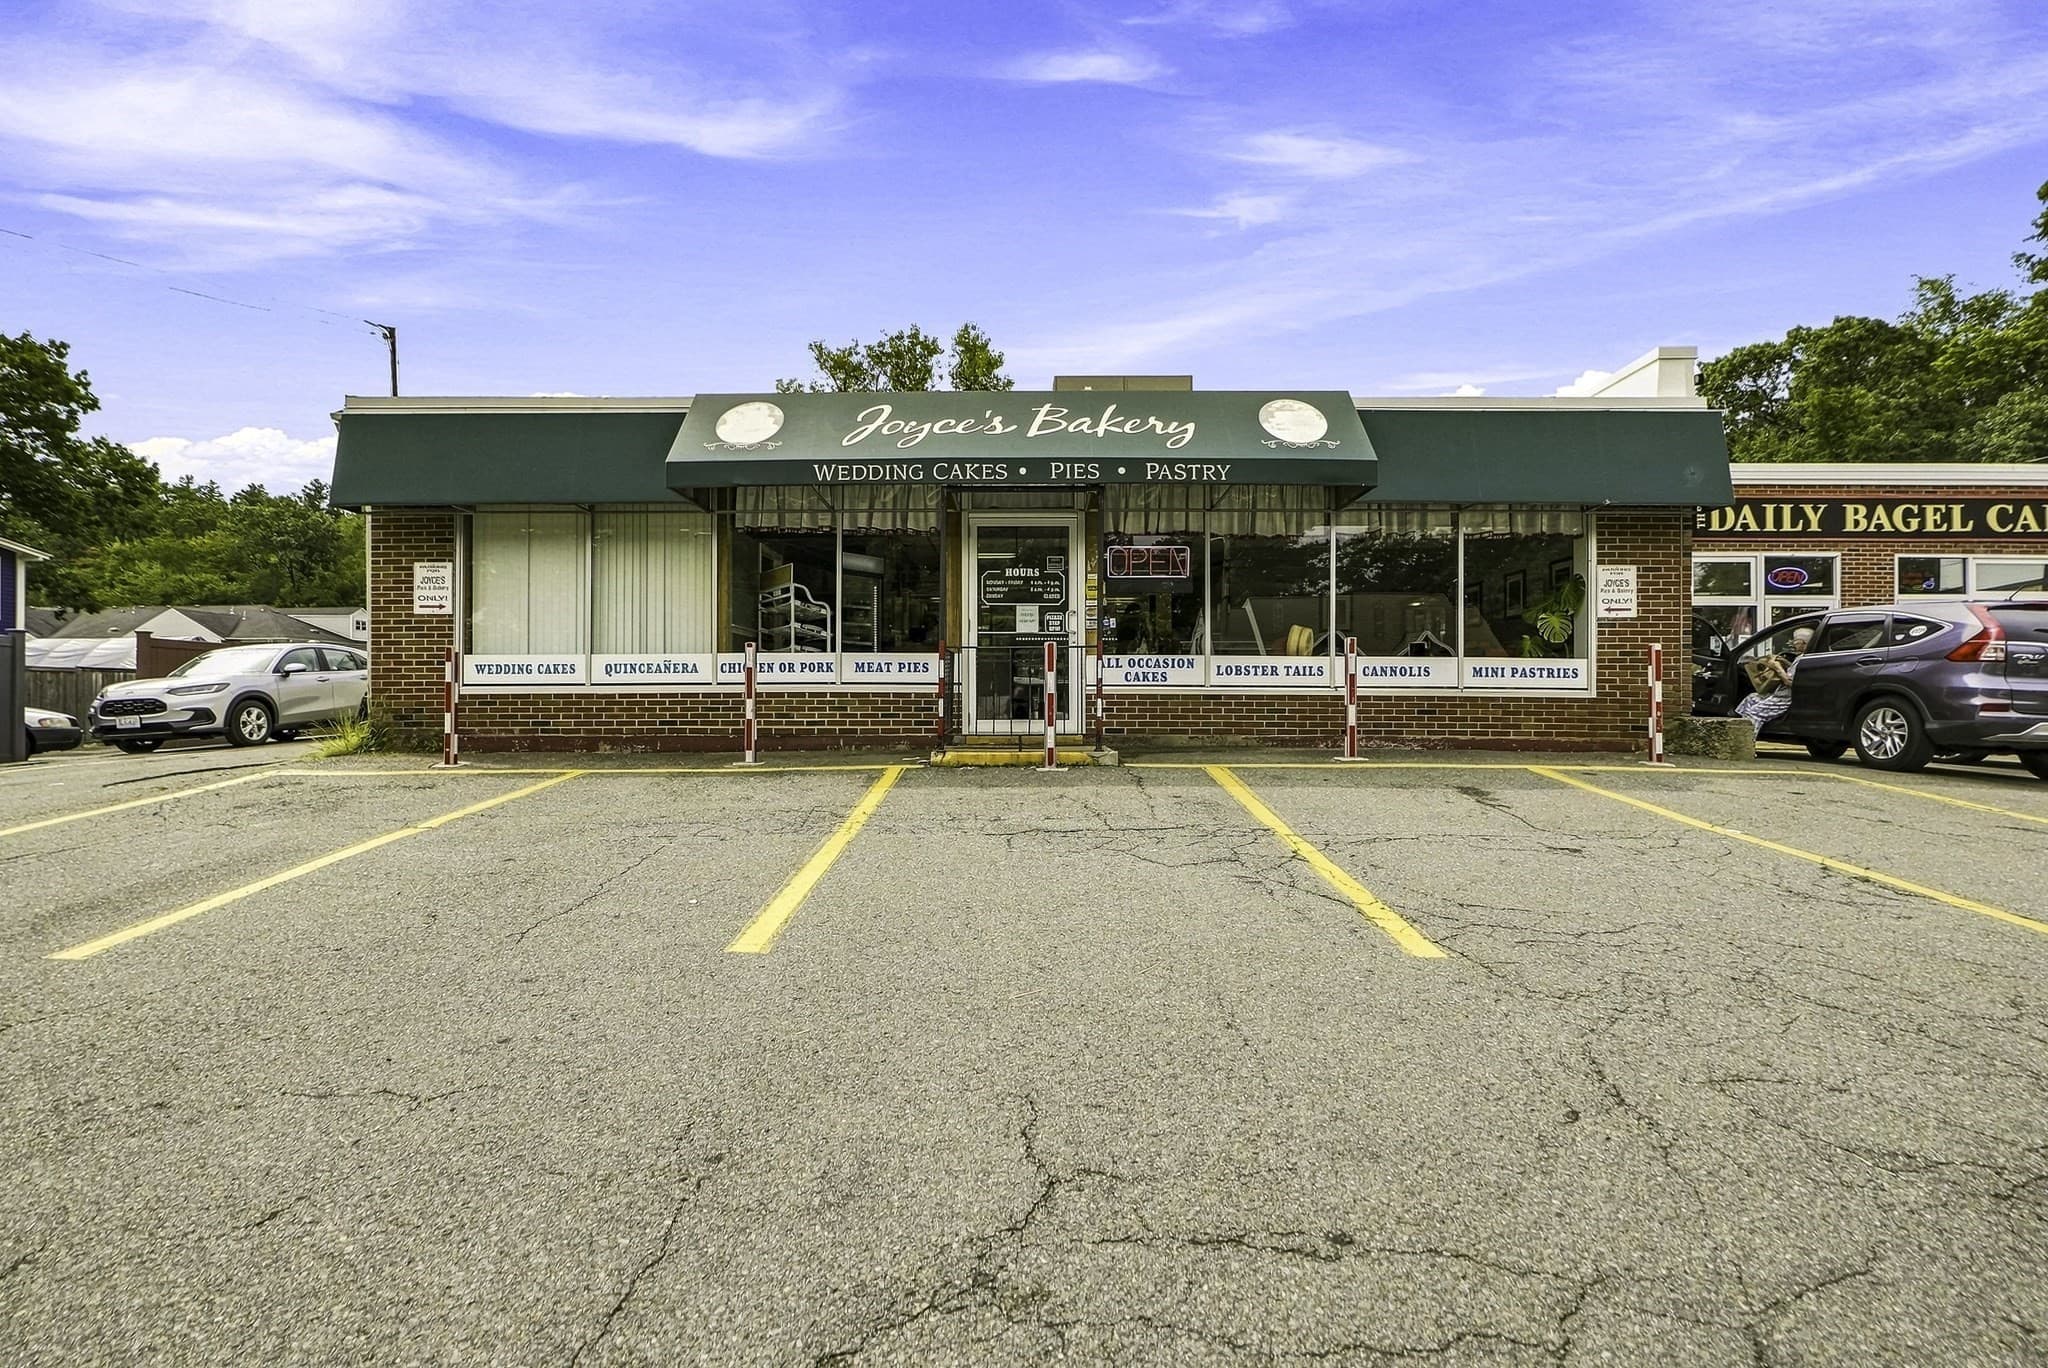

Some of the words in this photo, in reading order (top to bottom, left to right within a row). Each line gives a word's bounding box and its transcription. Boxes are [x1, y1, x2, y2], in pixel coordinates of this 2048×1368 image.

[841, 404, 1018, 449] Joyce's
[1026, 403, 1196, 449] Bakery
[812, 463, 924, 481] WEDDING
[933, 463, 1008, 481] CAKES
[1050, 462, 1100, 481] PIES
[1146, 462, 1231, 481] PASTRY
[1708, 503, 1828, 532] DAILY
[1841, 503, 1974, 533] BAGEL
[1110, 548, 1187, 576] OPEN
[1005, 567, 1040, 577] HOURS
[474, 663, 533, 675] WEDDING
[537, 663, 576, 675] CAKES
[604, 660, 699, 677] QUINCEAÑERA
[720, 662, 775, 674] CHIEN
[778, 662, 796, 673] OR
[799, 662, 834, 673] PORK
[854, 661, 893, 673] MEAT
[897, 661, 930, 673] PIES
[1127, 657, 1195, 669] OCCASION
[1124, 671, 1168, 682] CAKES
[1215, 664, 1280, 677] LOBSTER
[1283, 665, 1324, 677] TAILS
[1362, 665, 1431, 678] CANNOLIS
[1472, 666, 1506, 678] MINI
[1510, 667, 1579, 679] PASTRIES
